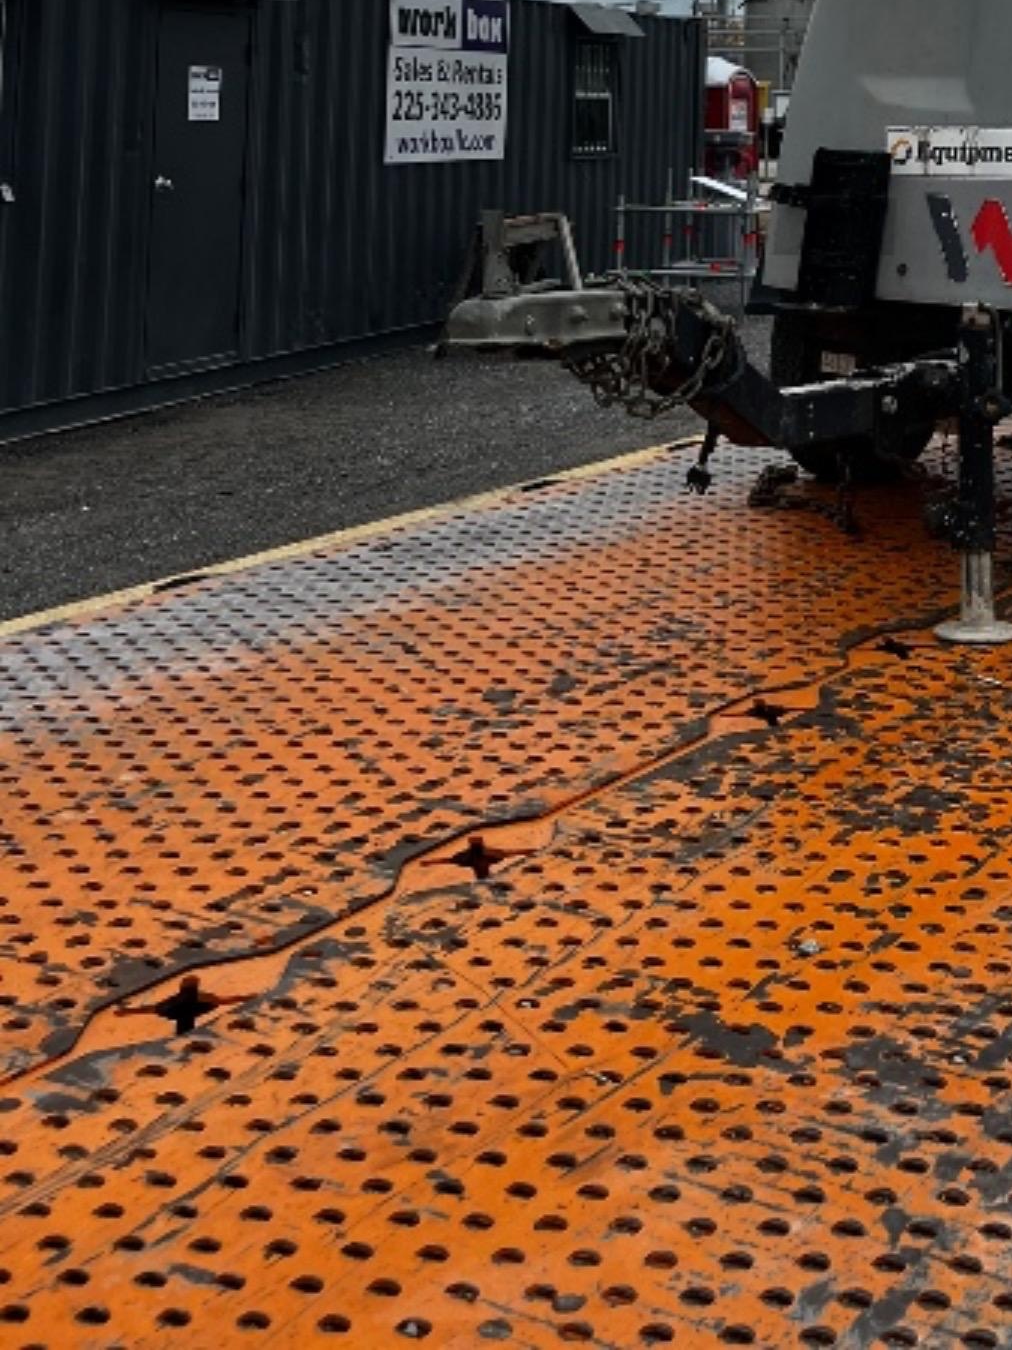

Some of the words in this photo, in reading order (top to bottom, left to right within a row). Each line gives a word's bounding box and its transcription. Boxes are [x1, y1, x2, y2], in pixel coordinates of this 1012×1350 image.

[397, 6, 458, 40] work
[466, 7, 503, 44] box
[394, 56, 433, 83] Sales
